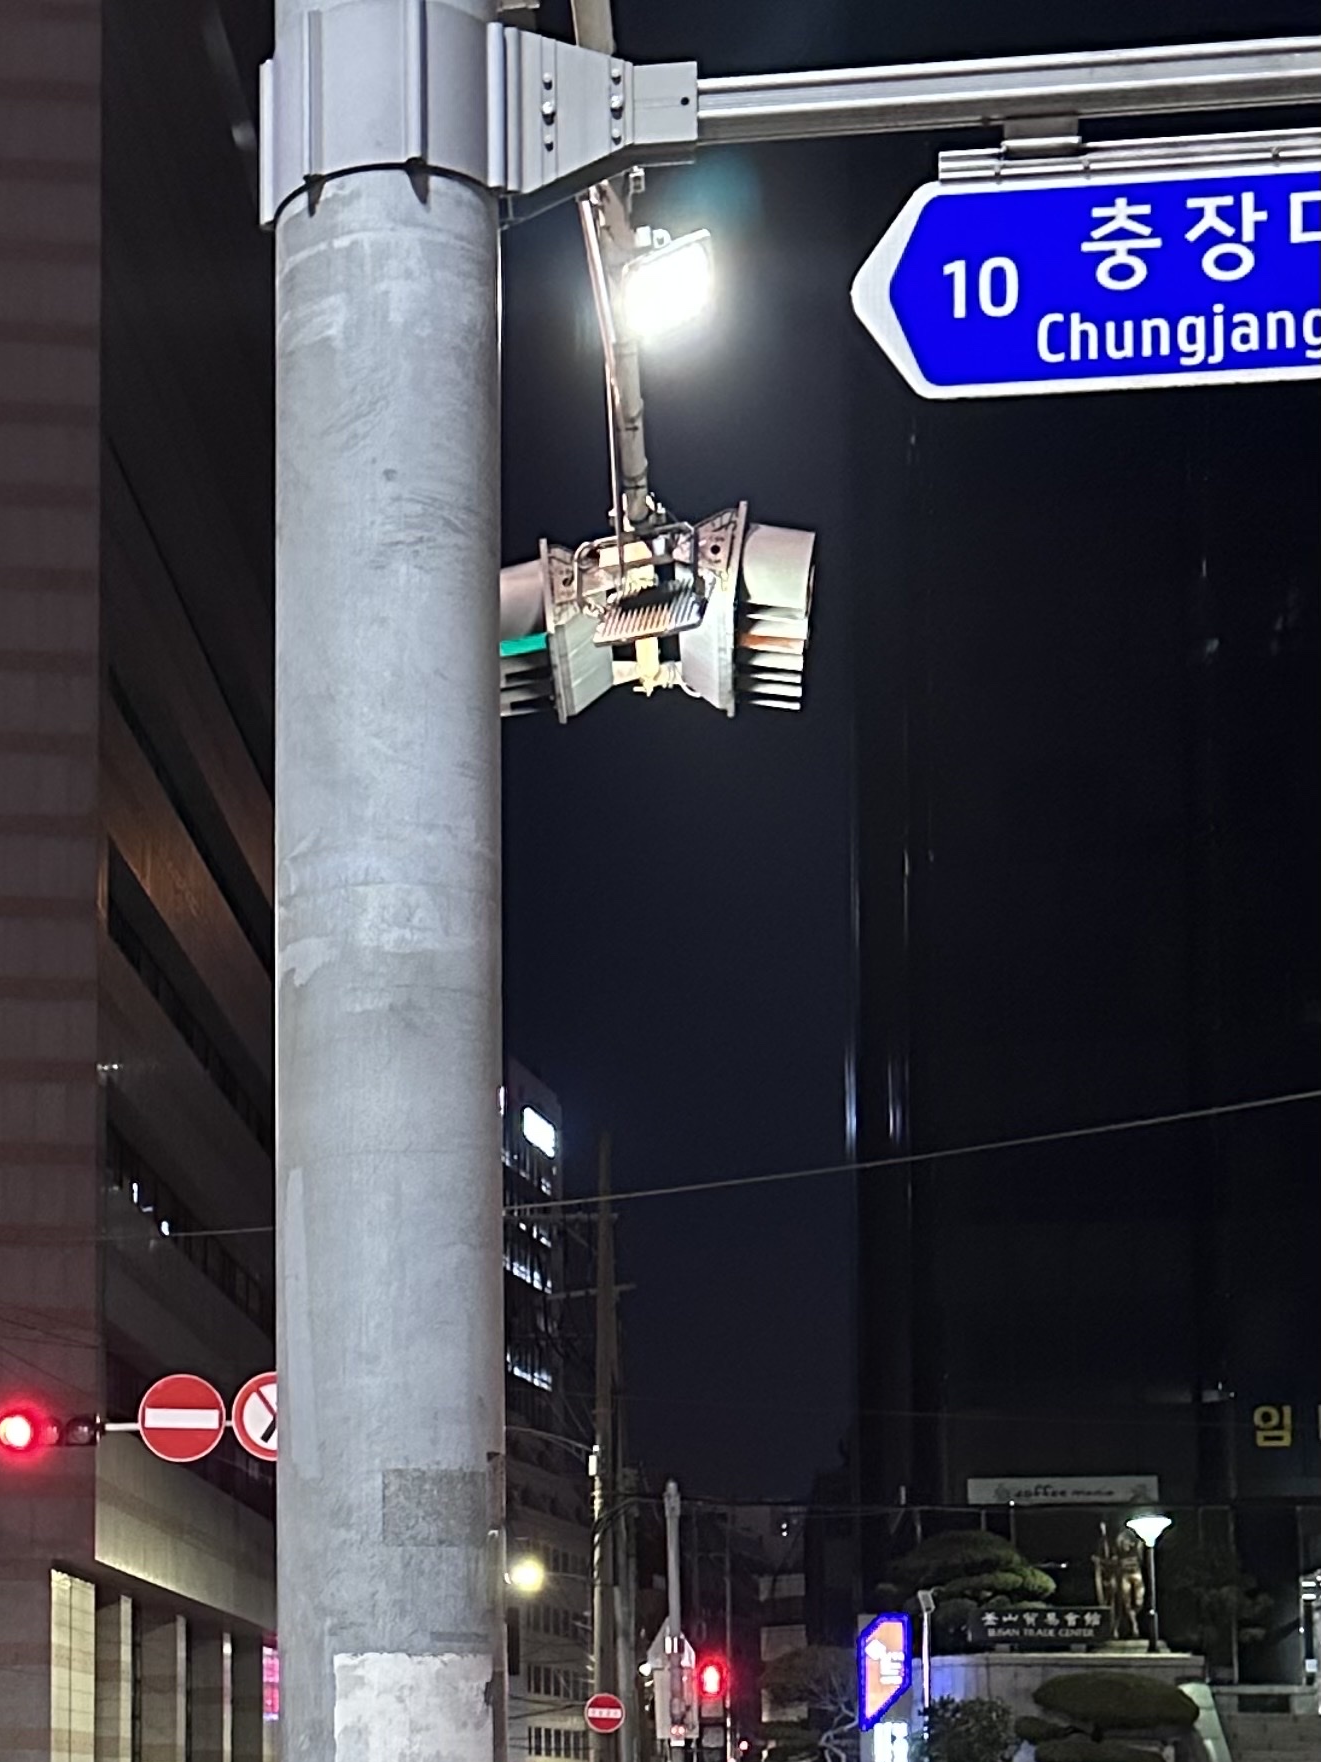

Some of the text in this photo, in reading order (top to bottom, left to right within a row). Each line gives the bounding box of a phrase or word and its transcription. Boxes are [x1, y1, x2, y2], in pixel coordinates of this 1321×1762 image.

[942, 256, 1019, 319] 10
[1036, 303, 1321, 367] Chungjang
[1253, 1404, 1321, 1447] 임
